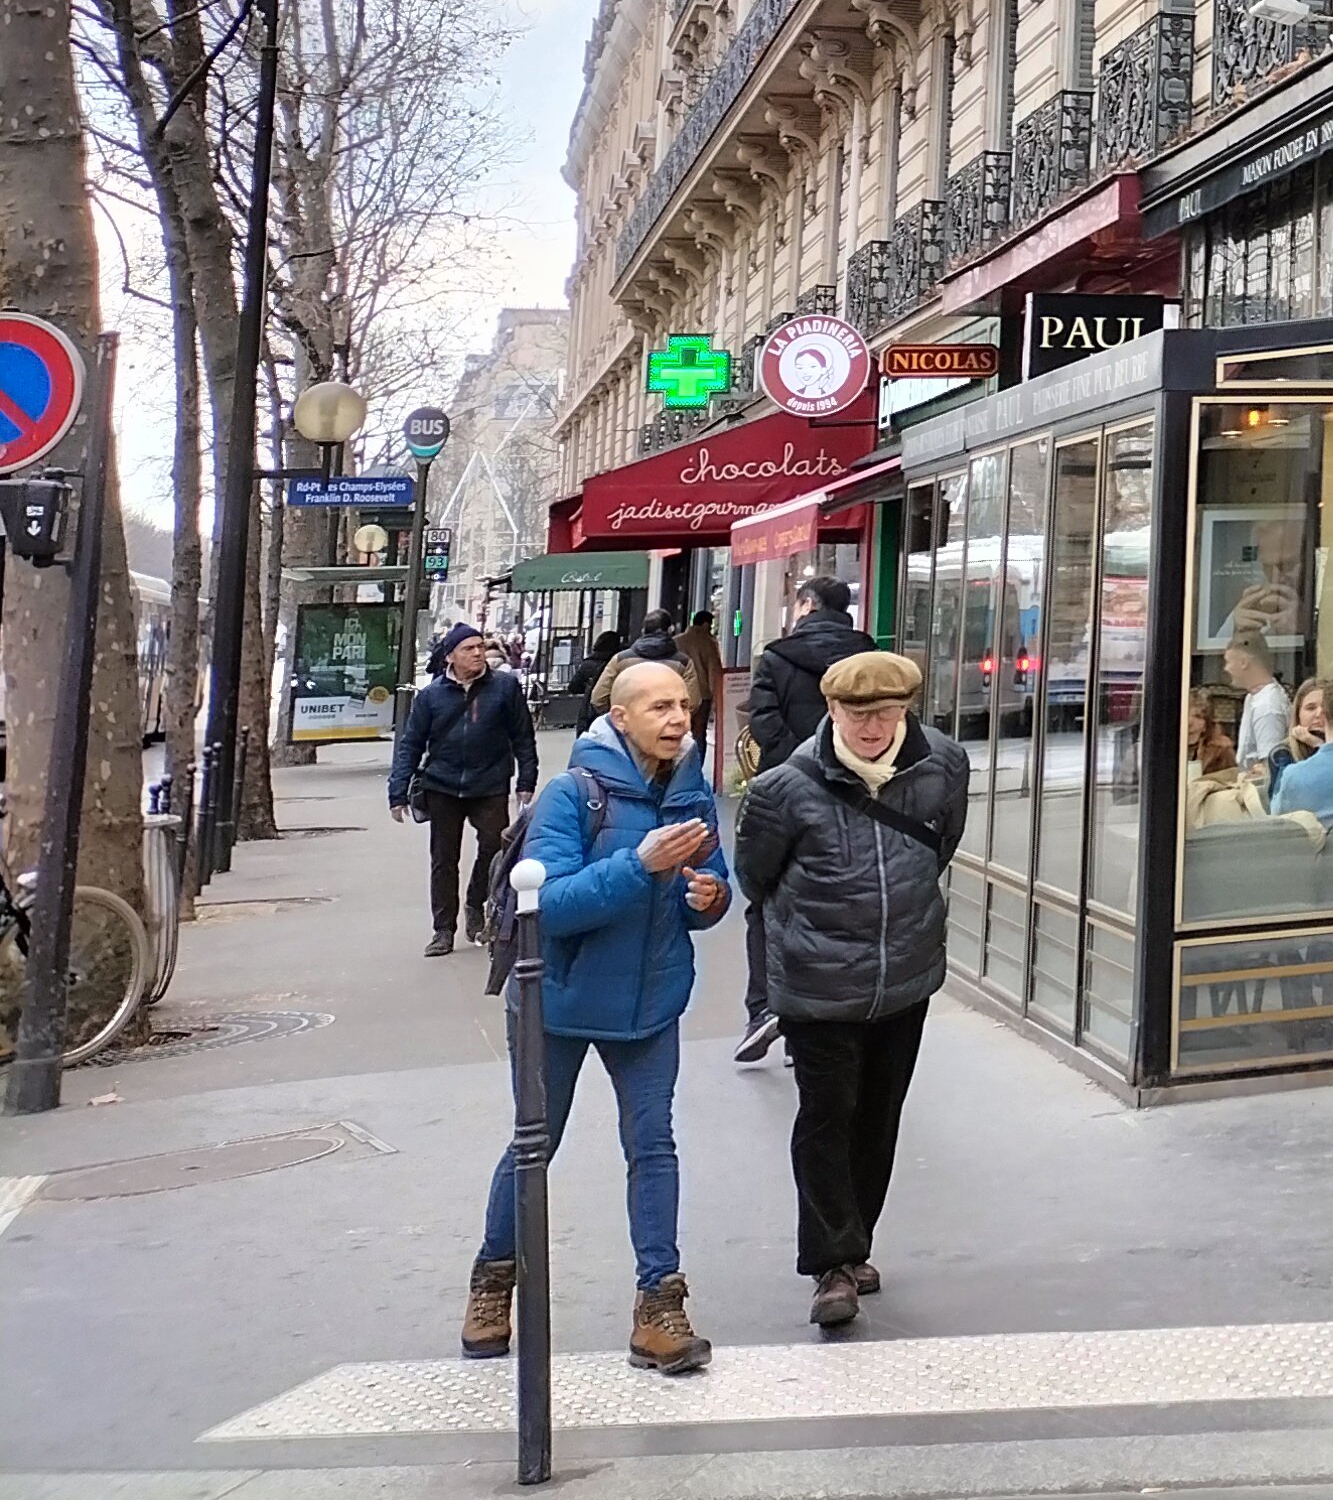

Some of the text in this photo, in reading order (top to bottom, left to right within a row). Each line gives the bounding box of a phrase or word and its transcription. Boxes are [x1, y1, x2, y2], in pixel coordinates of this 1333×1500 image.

[1305, 127, 1319, 153] EN
[768, 319, 864, 359] LA PIADINERIA
[892, 350, 993, 371] NICOLAS
[786, 395, 838, 412] depuis 1994
[996, 393, 1024, 431] PAUL
[409, 419, 445, 436] BUS
[679, 442, 848, 485] chocolats
[305, 493, 396, 504] Franklin D. Roosevelt
[430, 531, 447, 542] 80
[428, 556, 444, 567] 93
[333, 633, 367, 647] MON
[332, 646, 366, 661] PARI
[300, 703, 346, 715] UNIBET
